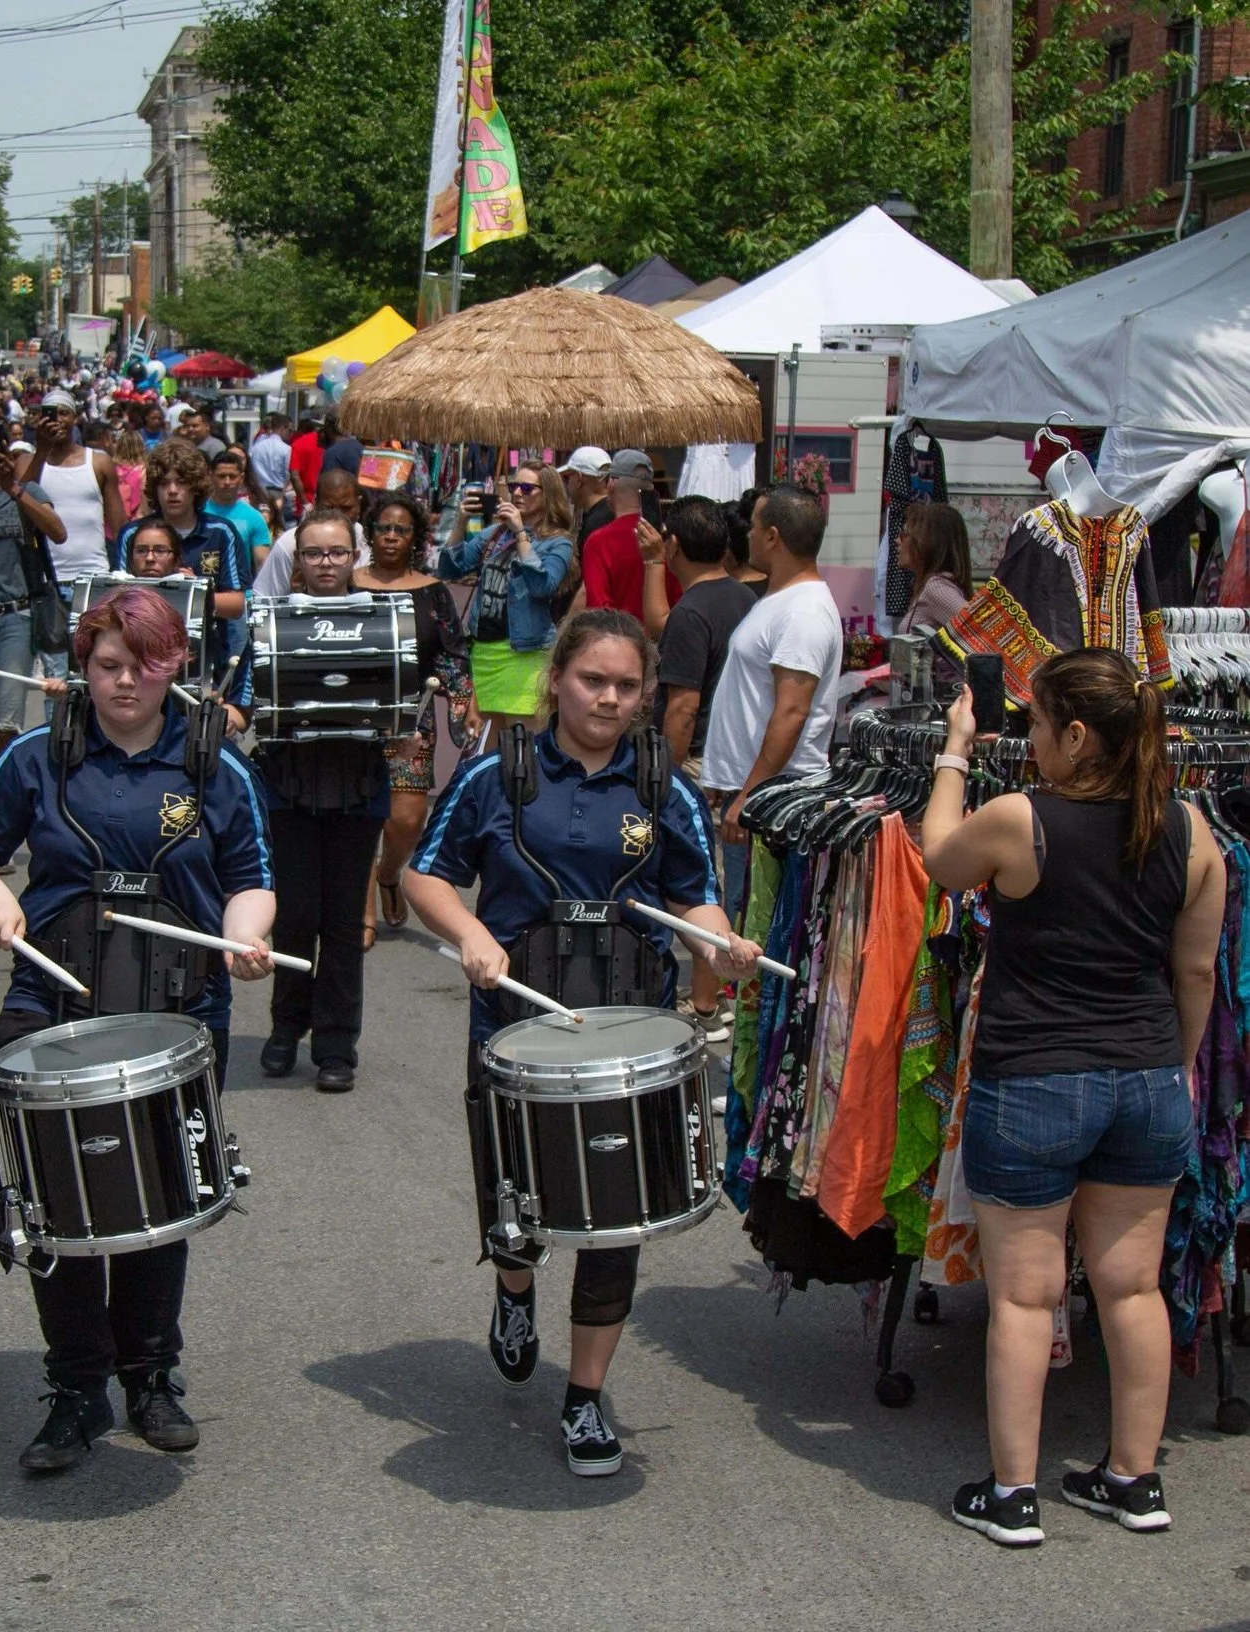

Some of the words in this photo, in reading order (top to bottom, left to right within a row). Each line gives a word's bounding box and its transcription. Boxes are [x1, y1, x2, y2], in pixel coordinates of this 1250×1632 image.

[306, 620, 364, 641] Pearl
[102, 873, 149, 894] Pearl
[563, 901, 609, 922] Pearl
